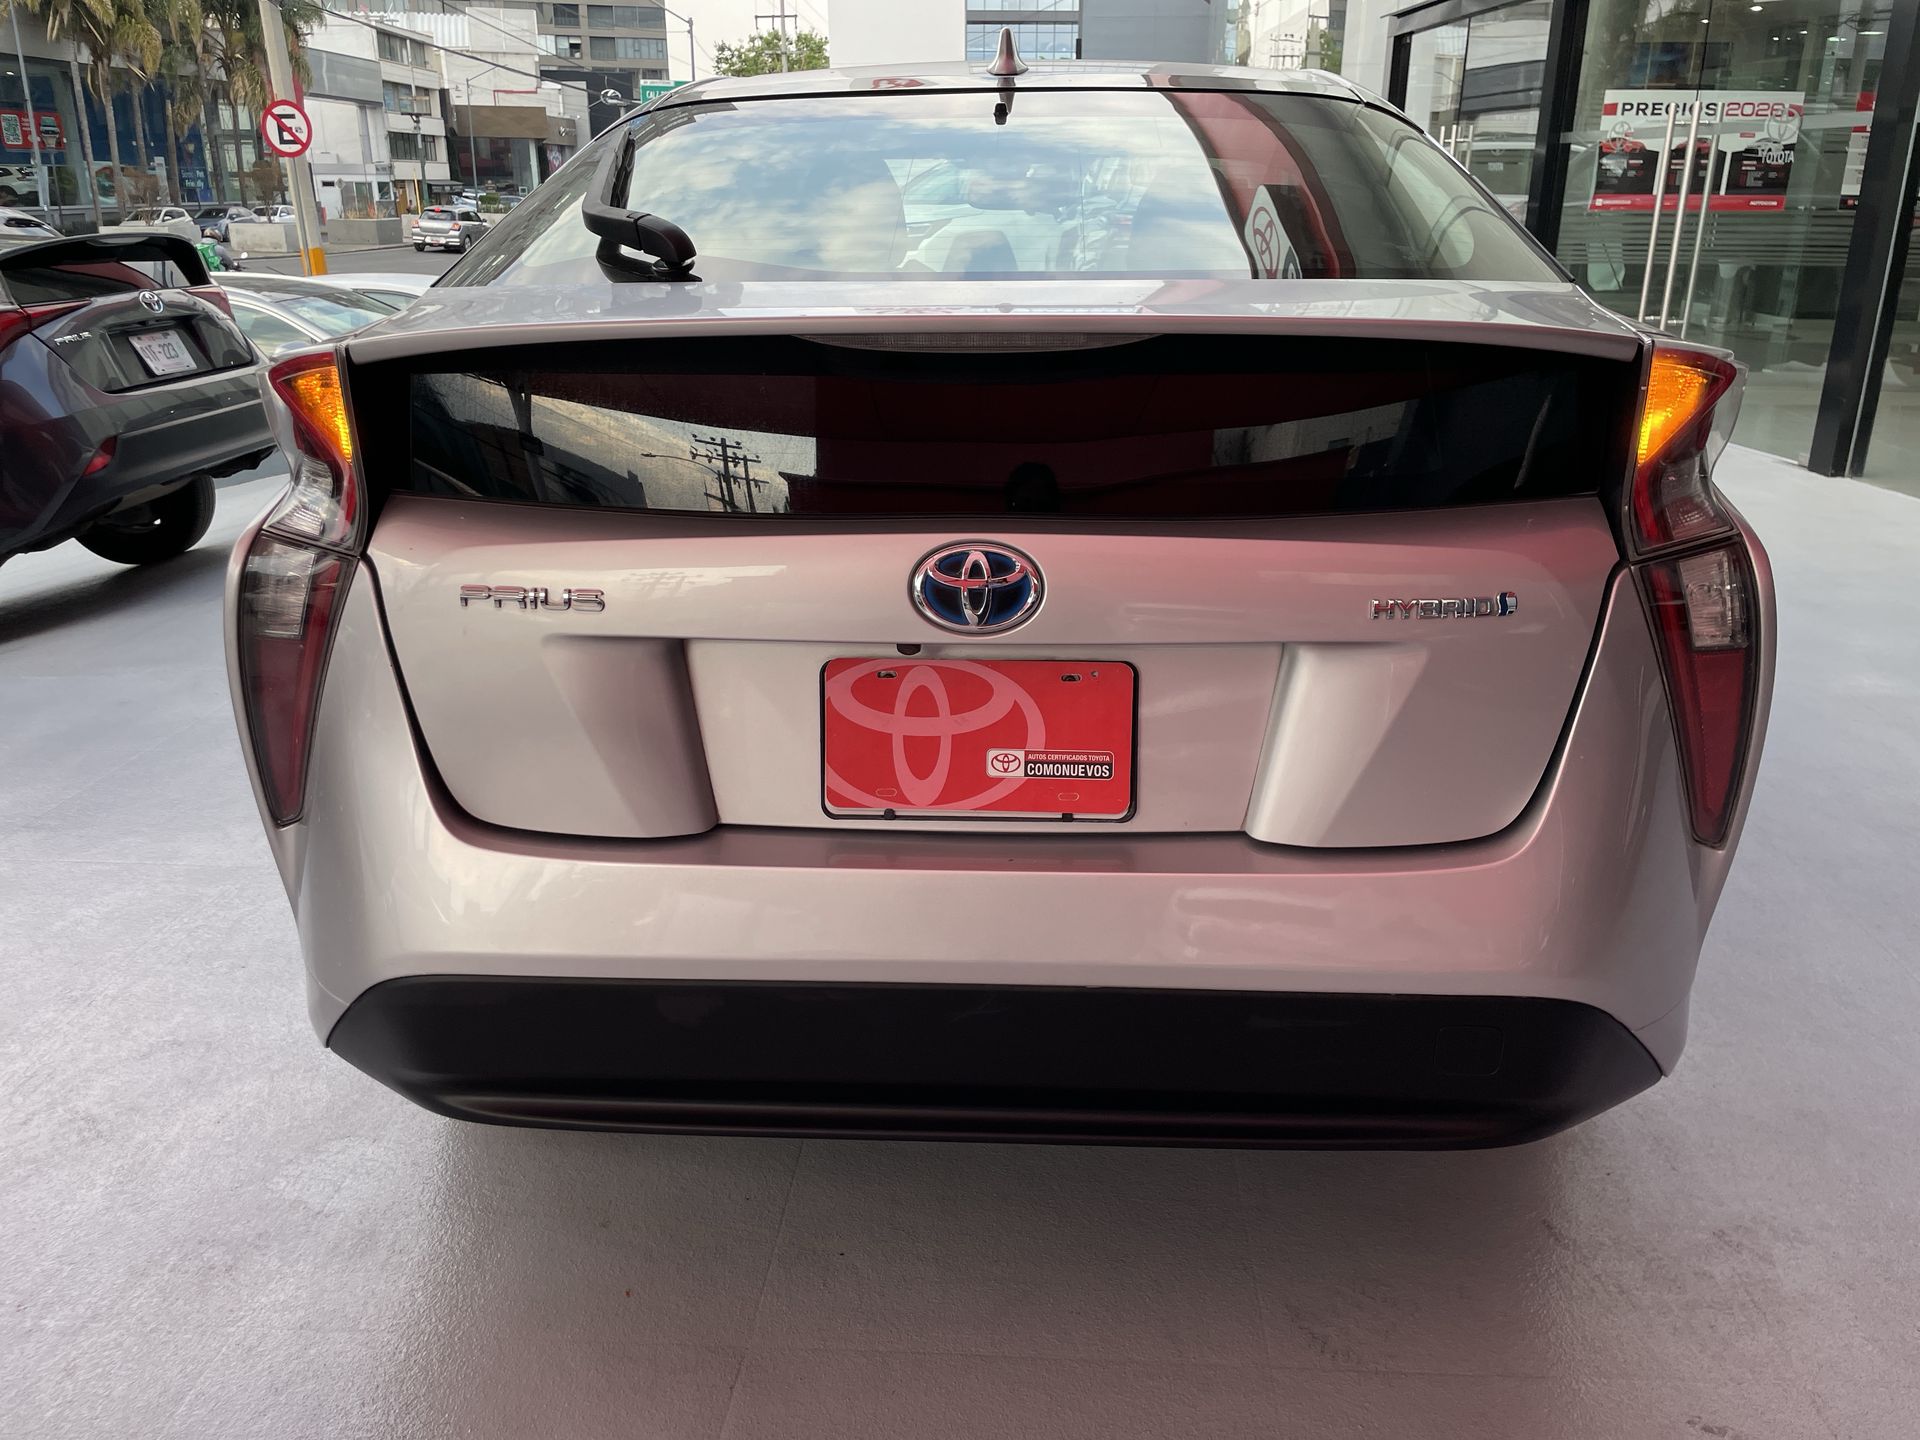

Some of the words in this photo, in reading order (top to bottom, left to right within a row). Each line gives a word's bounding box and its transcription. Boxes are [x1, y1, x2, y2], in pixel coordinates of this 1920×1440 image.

[1621, 102, 1717, 116] PRECIOS
[1725, 102, 1785, 117] 2026
[276, 114, 299, 144] E
[1759, 147, 1794, 164] TOYOTA
[54, 332, 92, 346] PRIUS
[459, 584, 606, 612] PRIUS
[1369, 598, 1492, 619] HYBRID
[1027, 763, 1110, 777] COMONUEVOS
